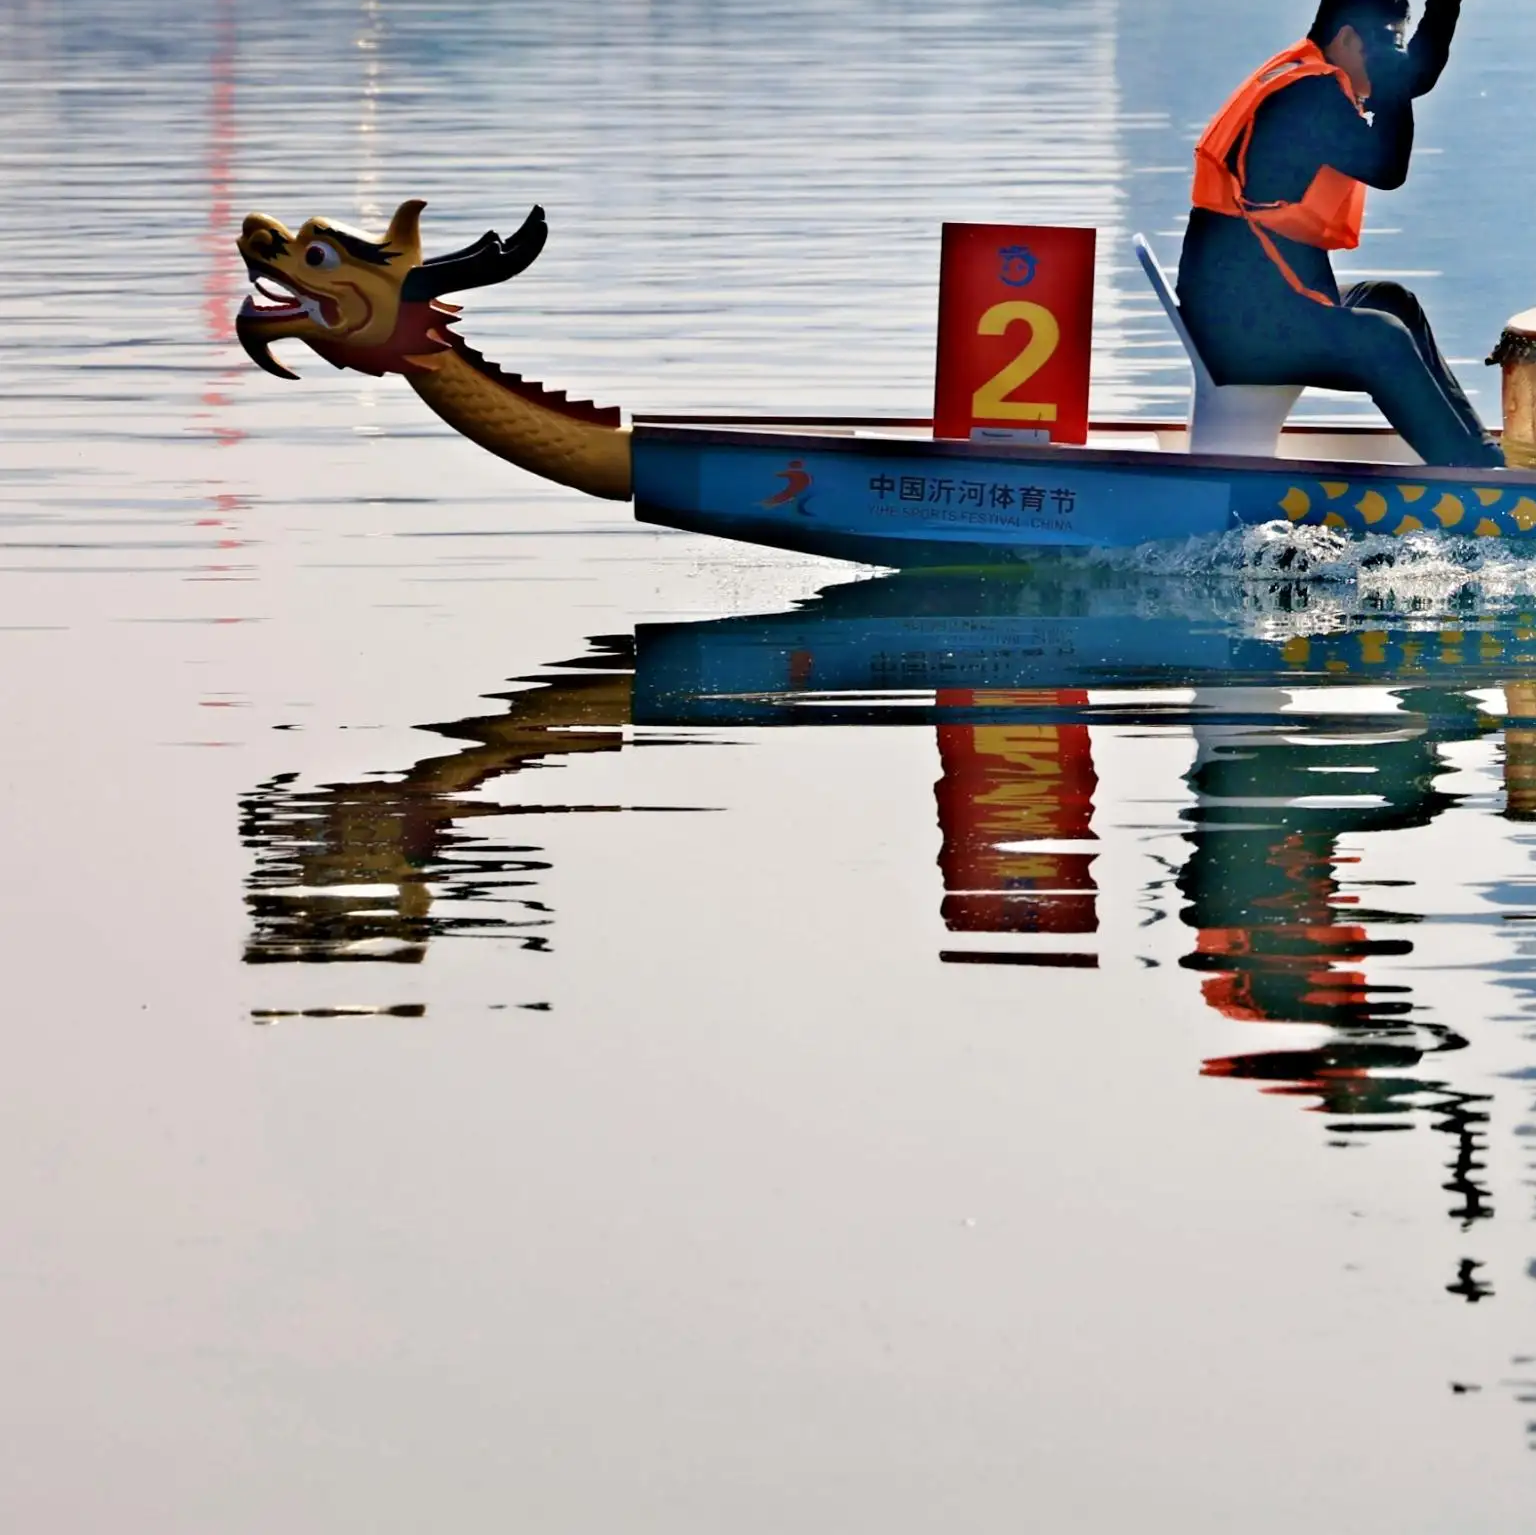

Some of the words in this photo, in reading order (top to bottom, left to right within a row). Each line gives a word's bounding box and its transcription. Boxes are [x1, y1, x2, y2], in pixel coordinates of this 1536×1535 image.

[971, 300, 1059, 421] 2
[869, 473, 1077, 514] 中国沂河体育节
[903, 507, 957, 522] SPORTS
[1031, 517, 1073, 531] CHINA
